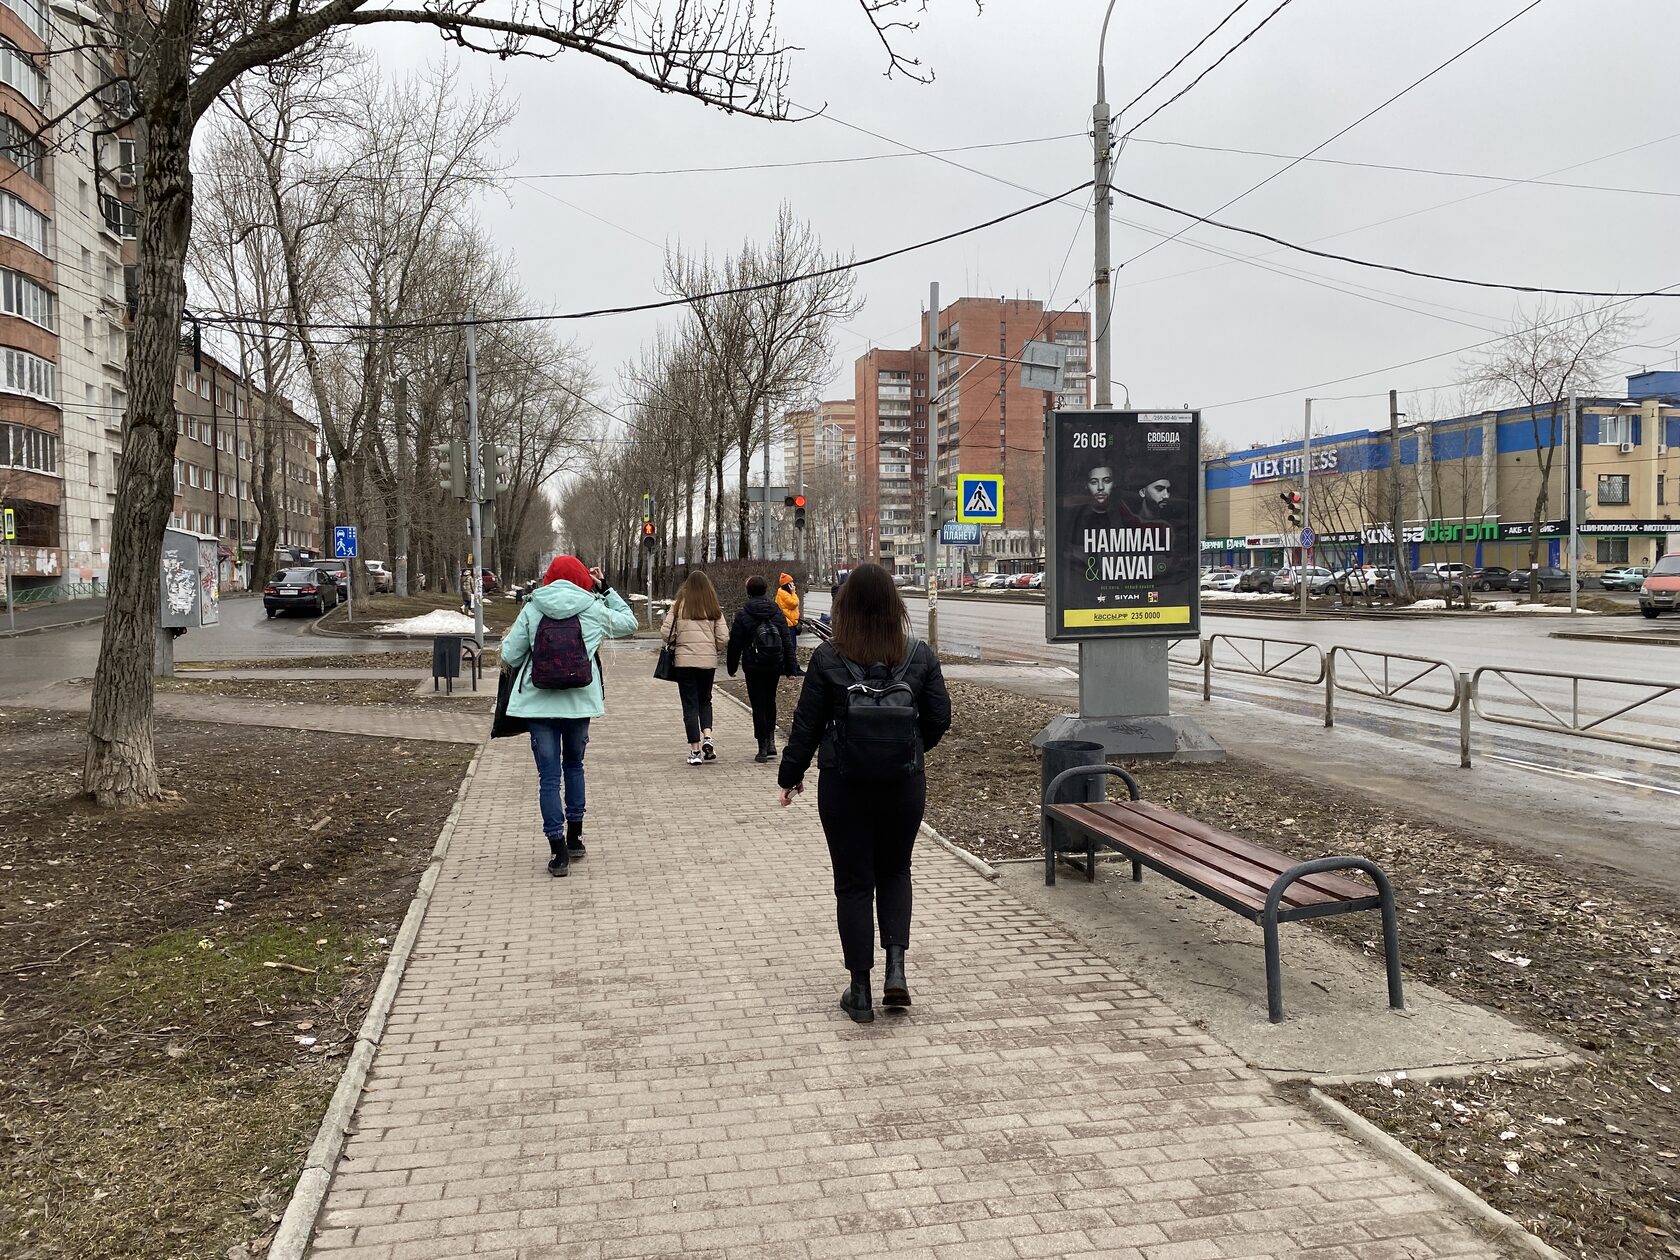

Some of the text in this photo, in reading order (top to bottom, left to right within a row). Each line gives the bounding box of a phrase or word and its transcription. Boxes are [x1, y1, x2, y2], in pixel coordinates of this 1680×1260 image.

[1073, 432, 1089, 449] 26
[1091, 432, 1107, 449] 05
[1147, 431, 1180, 444] СВОБОДА
[1249, 459, 1280, 480] ALEX
[1508, 526, 1523, 534] АКБ
[1579, 524, 1639, 532] ШИНОМОНТАЖ
[944, 531, 977, 540] ПЛАНЕТУ
[1084, 527, 1171, 553] HAMMALI
[1085, 556, 1100, 581] &
[1101, 555, 1153, 581] NAVAI
[1131, 612, 1143, 620] 235
[1144, 611, 1161, 619] 0000
